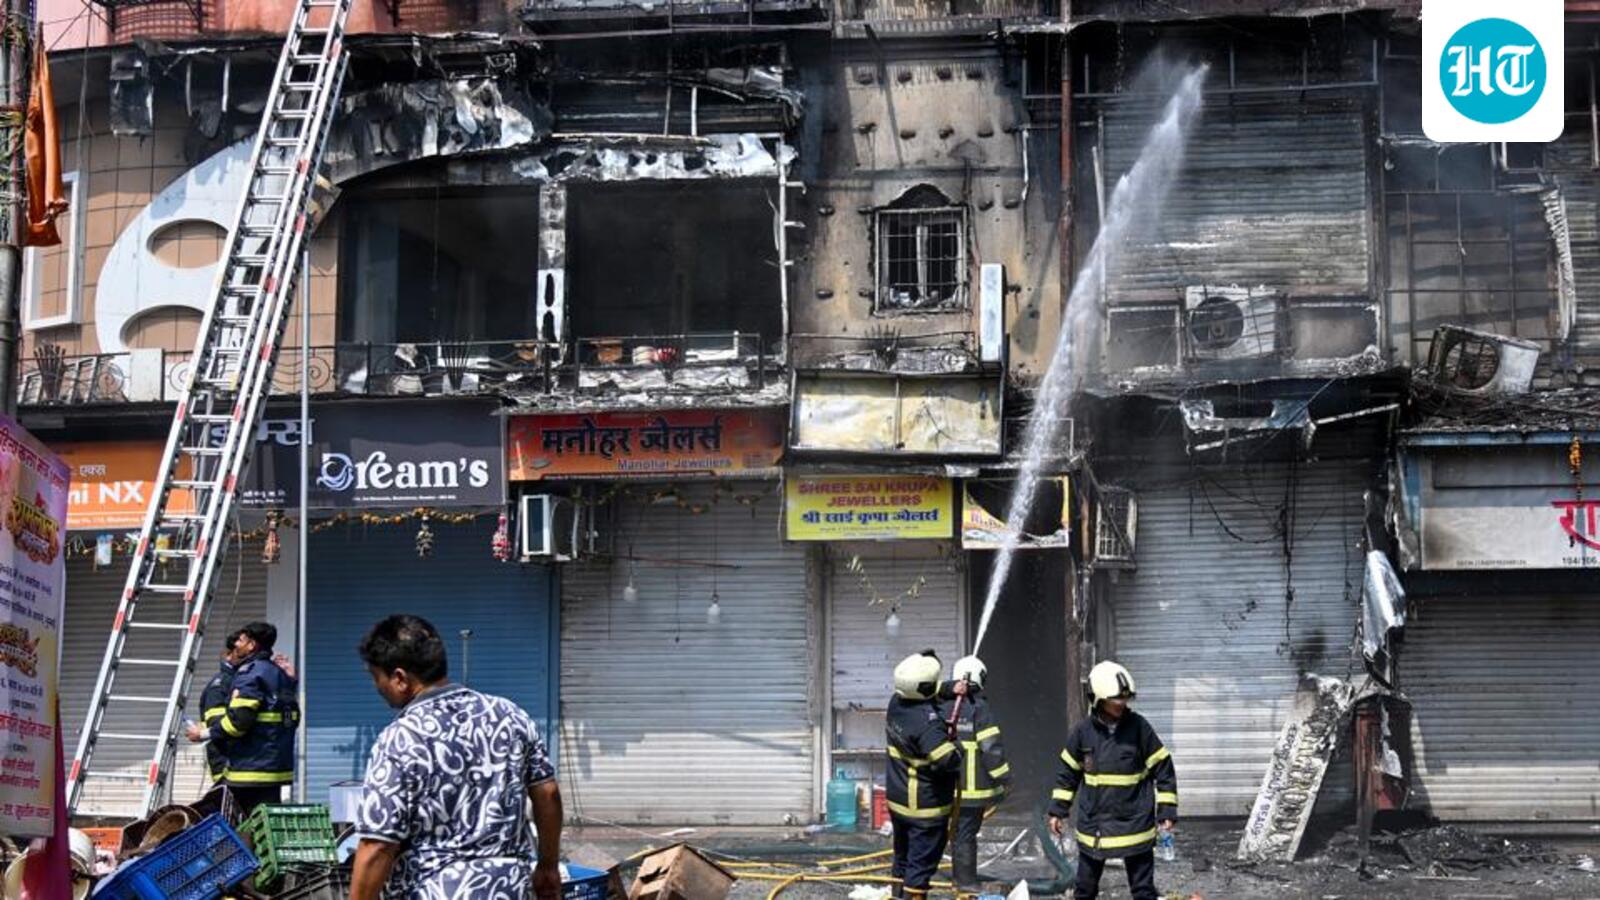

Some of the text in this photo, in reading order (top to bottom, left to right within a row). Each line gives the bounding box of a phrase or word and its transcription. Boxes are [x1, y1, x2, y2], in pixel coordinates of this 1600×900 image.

[542, 418, 632, 460] मनोहर
[317, 451, 489, 491] Dream's
[618, 458, 732, 471] Manohar Jewellers
[99, 481, 144, 504] NX
[800, 478, 940, 494] SHREE SAI KRUPA
[827, 494, 922, 507] JEWELLERS
[802, 510, 821, 524] श्री
[857, 510, 889, 525] कृपा
